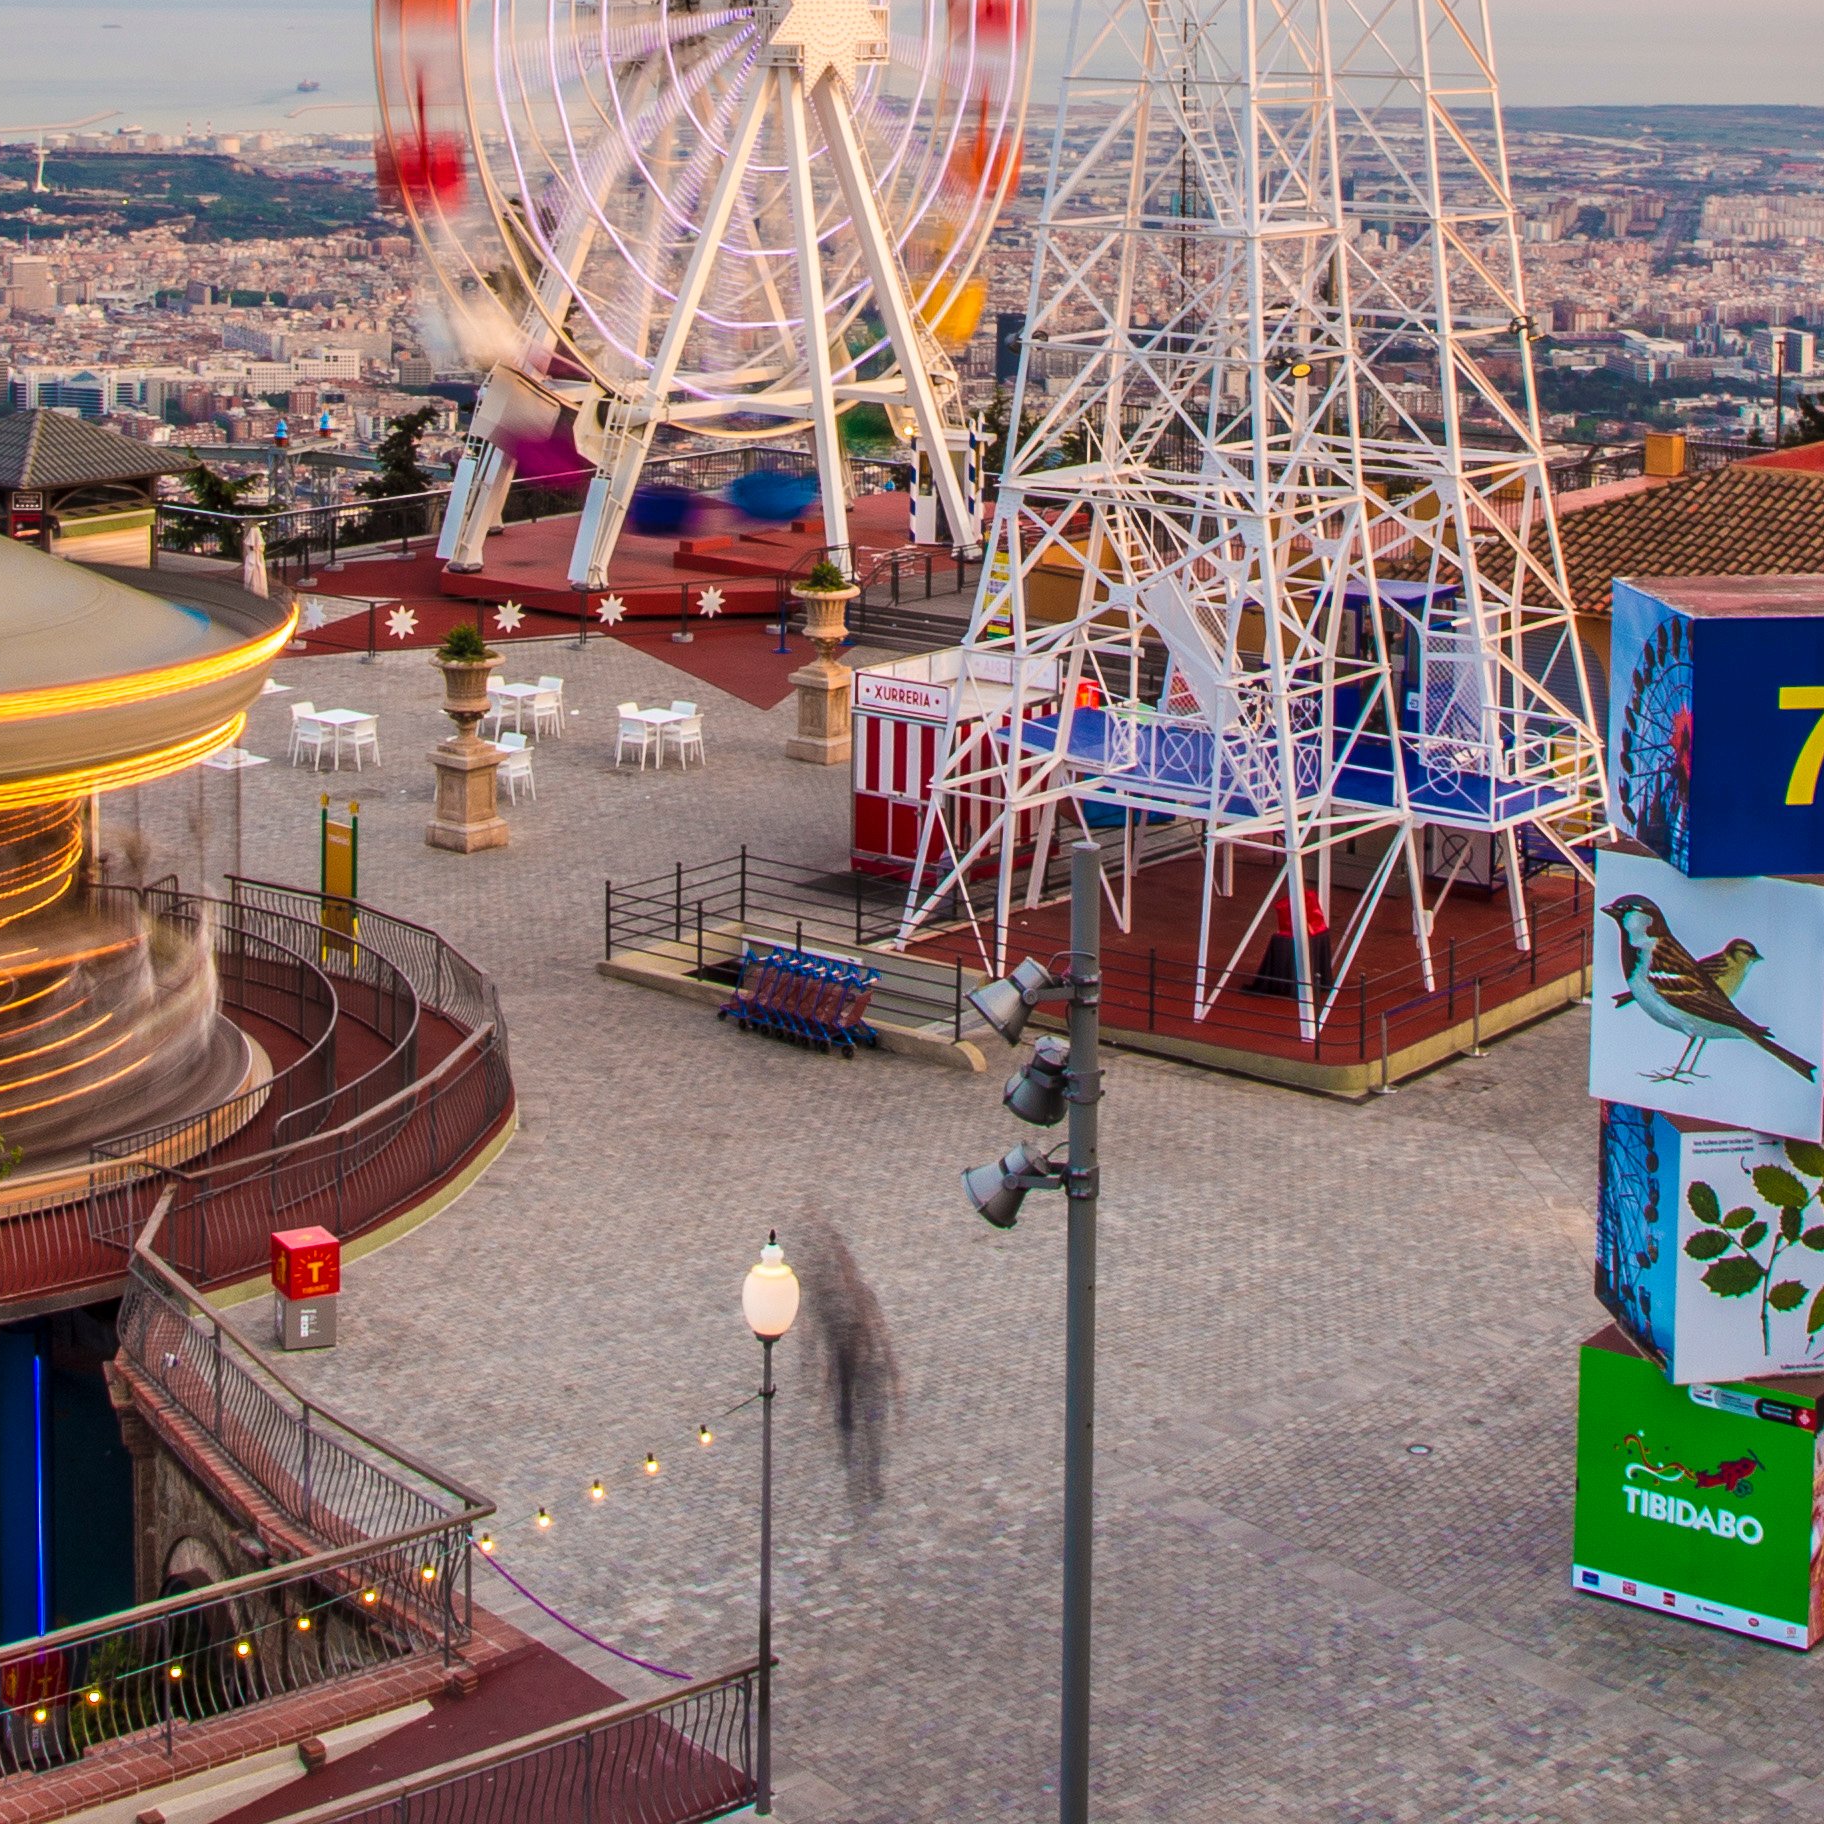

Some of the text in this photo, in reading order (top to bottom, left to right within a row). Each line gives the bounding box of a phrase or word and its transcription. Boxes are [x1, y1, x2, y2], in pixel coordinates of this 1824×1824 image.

[875, 685, 930, 707] XURRERIA
[307, 1261, 324, 1283] T
[1622, 1484, 1764, 1545] TIBIDABO
